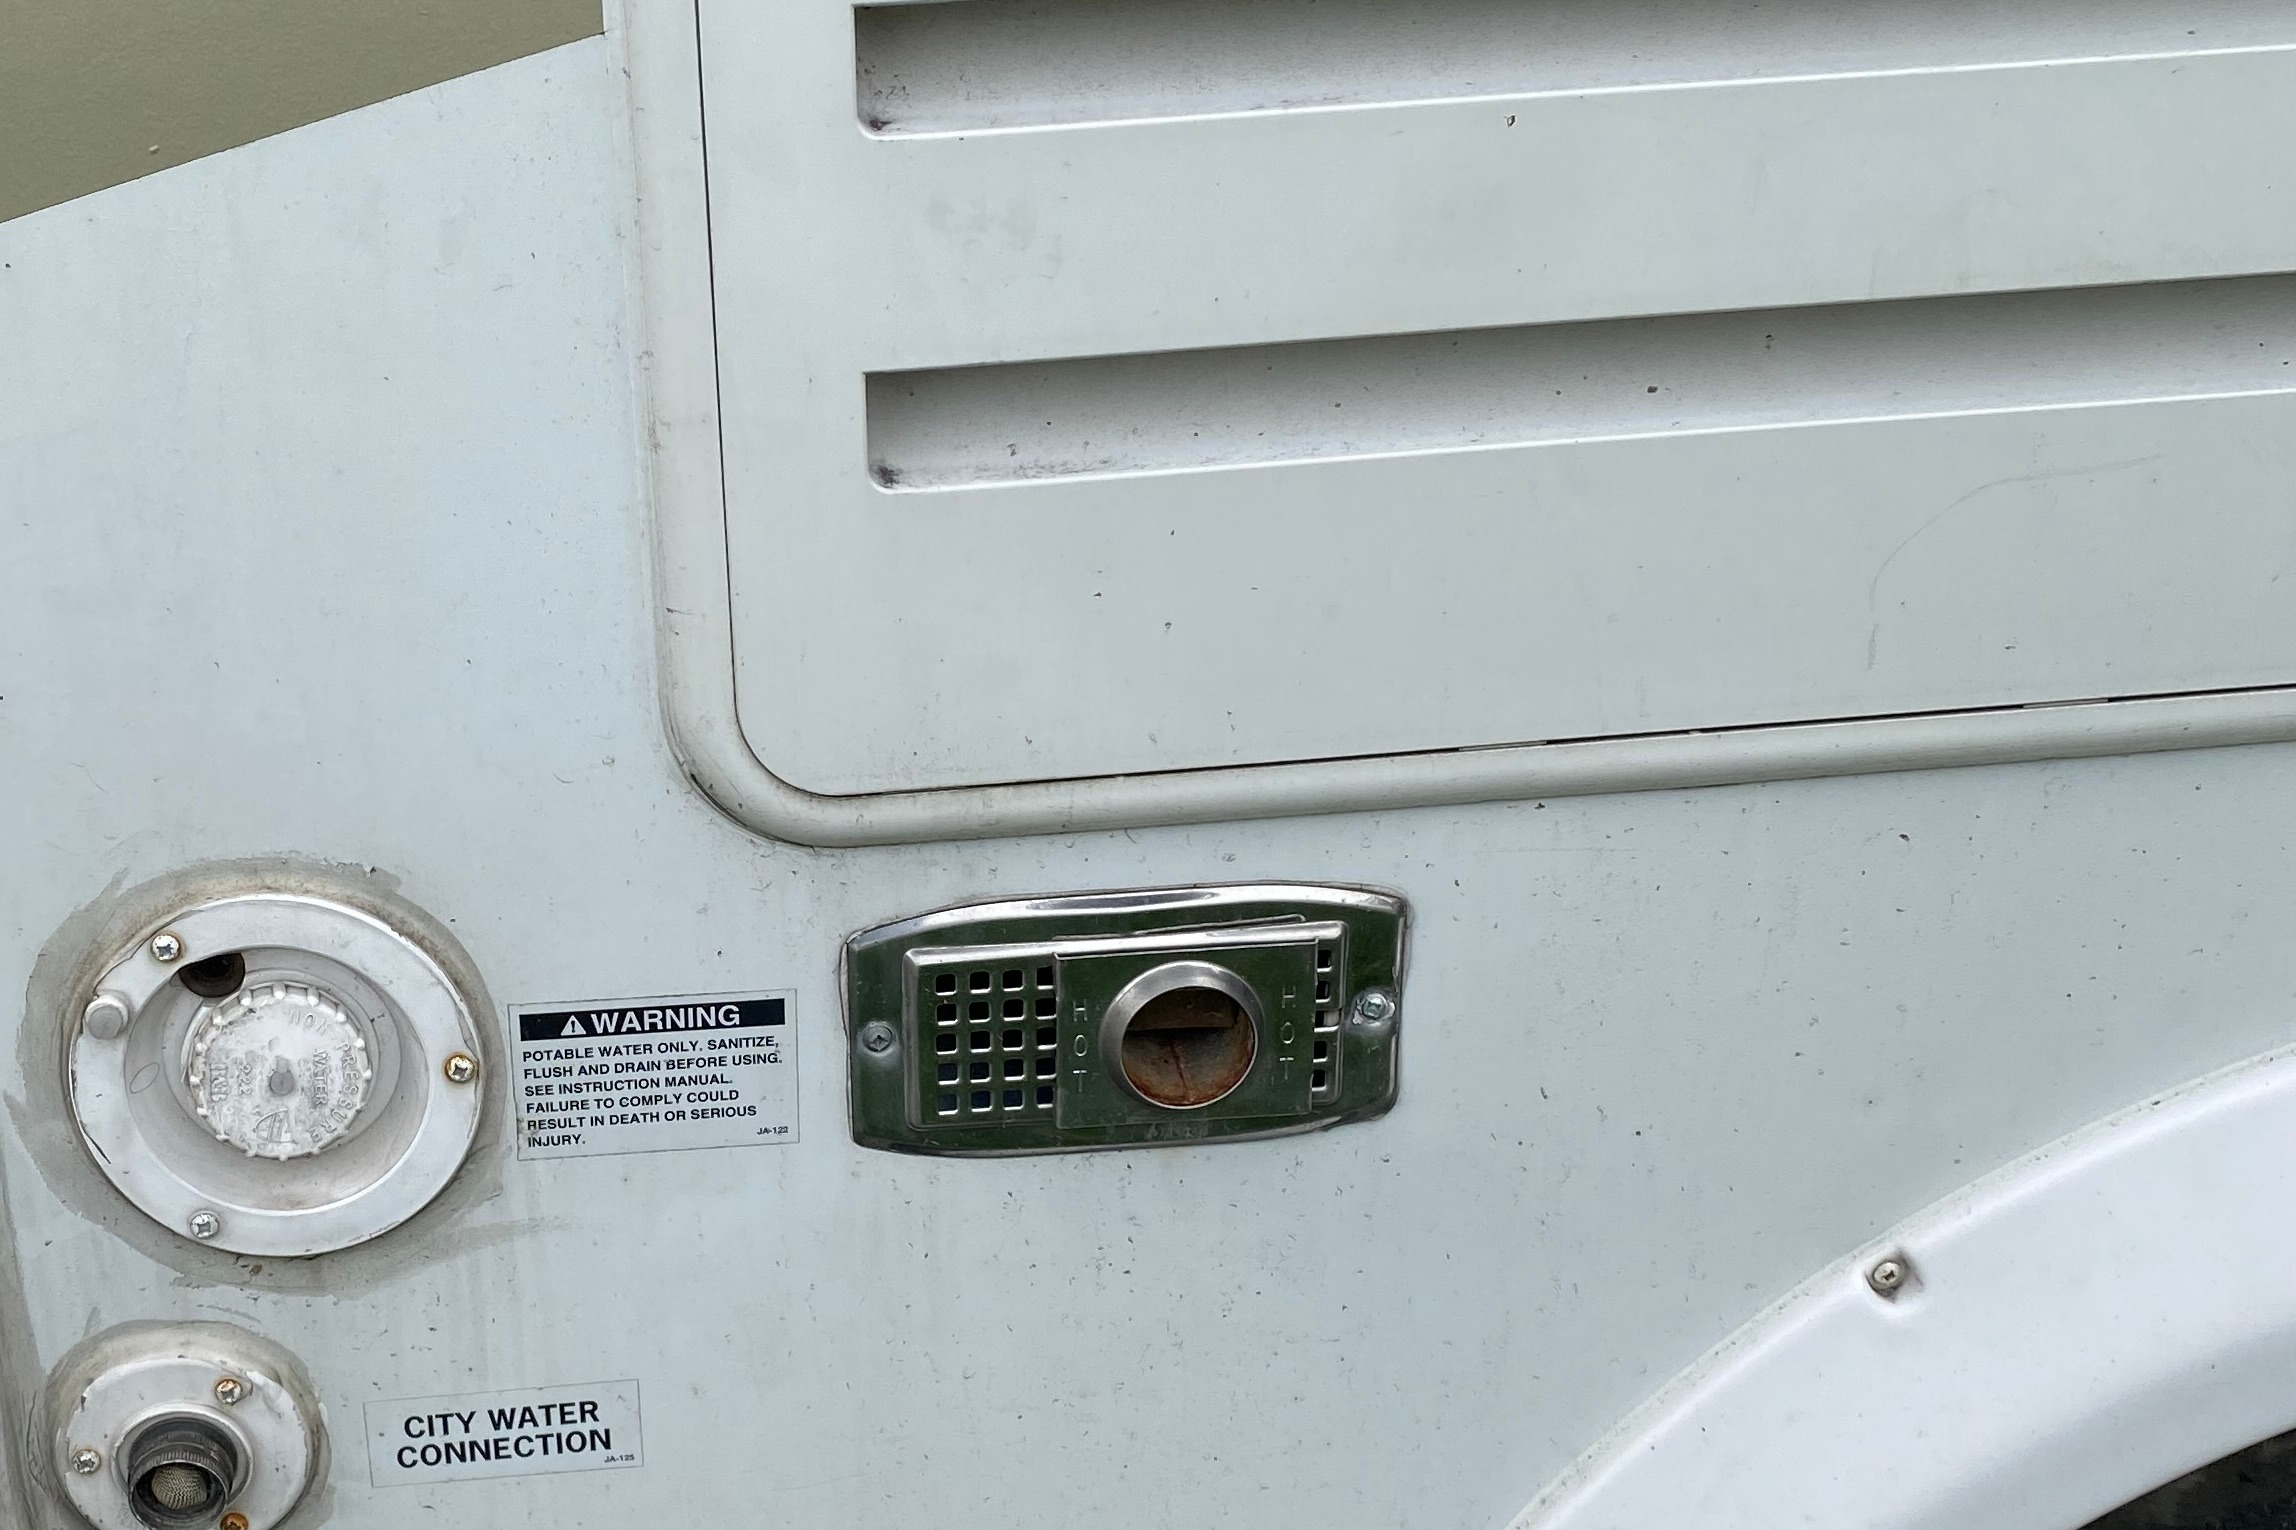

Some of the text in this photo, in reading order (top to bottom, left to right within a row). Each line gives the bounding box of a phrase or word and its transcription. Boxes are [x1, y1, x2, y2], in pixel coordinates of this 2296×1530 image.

[590, 1004, 740, 1033] WARNING
[1073, 999, 1088, 1093] HOT
[1279, 985, 1297, 1080] HOT
[523, 1036, 779, 1062] POTABLE WATER ONLY. SANITIZE,
[313, 1049, 329, 1105] WATER
[524, 1052, 783, 1079] FLUSH AND DRAIN BEFORE USING.
[308, 1041, 359, 1143] PRESSURE
[525, 1073, 733, 1097] SEE INSTRUCTION MANUAL.
[526, 1090, 739, 1114] FAILURE TO COMPLY COULD
[527, 1105, 757, 1131] RESULT IN DEATH OR SERIOUS
[757, 1125, 789, 1136] JA-122
[528, 1133, 586, 1148] INJURY.
[403, 1400, 600, 1439] CITY WATER
[396, 1428, 612, 1469] CONNECTION
[604, 1453, 635, 1463] JA-125
